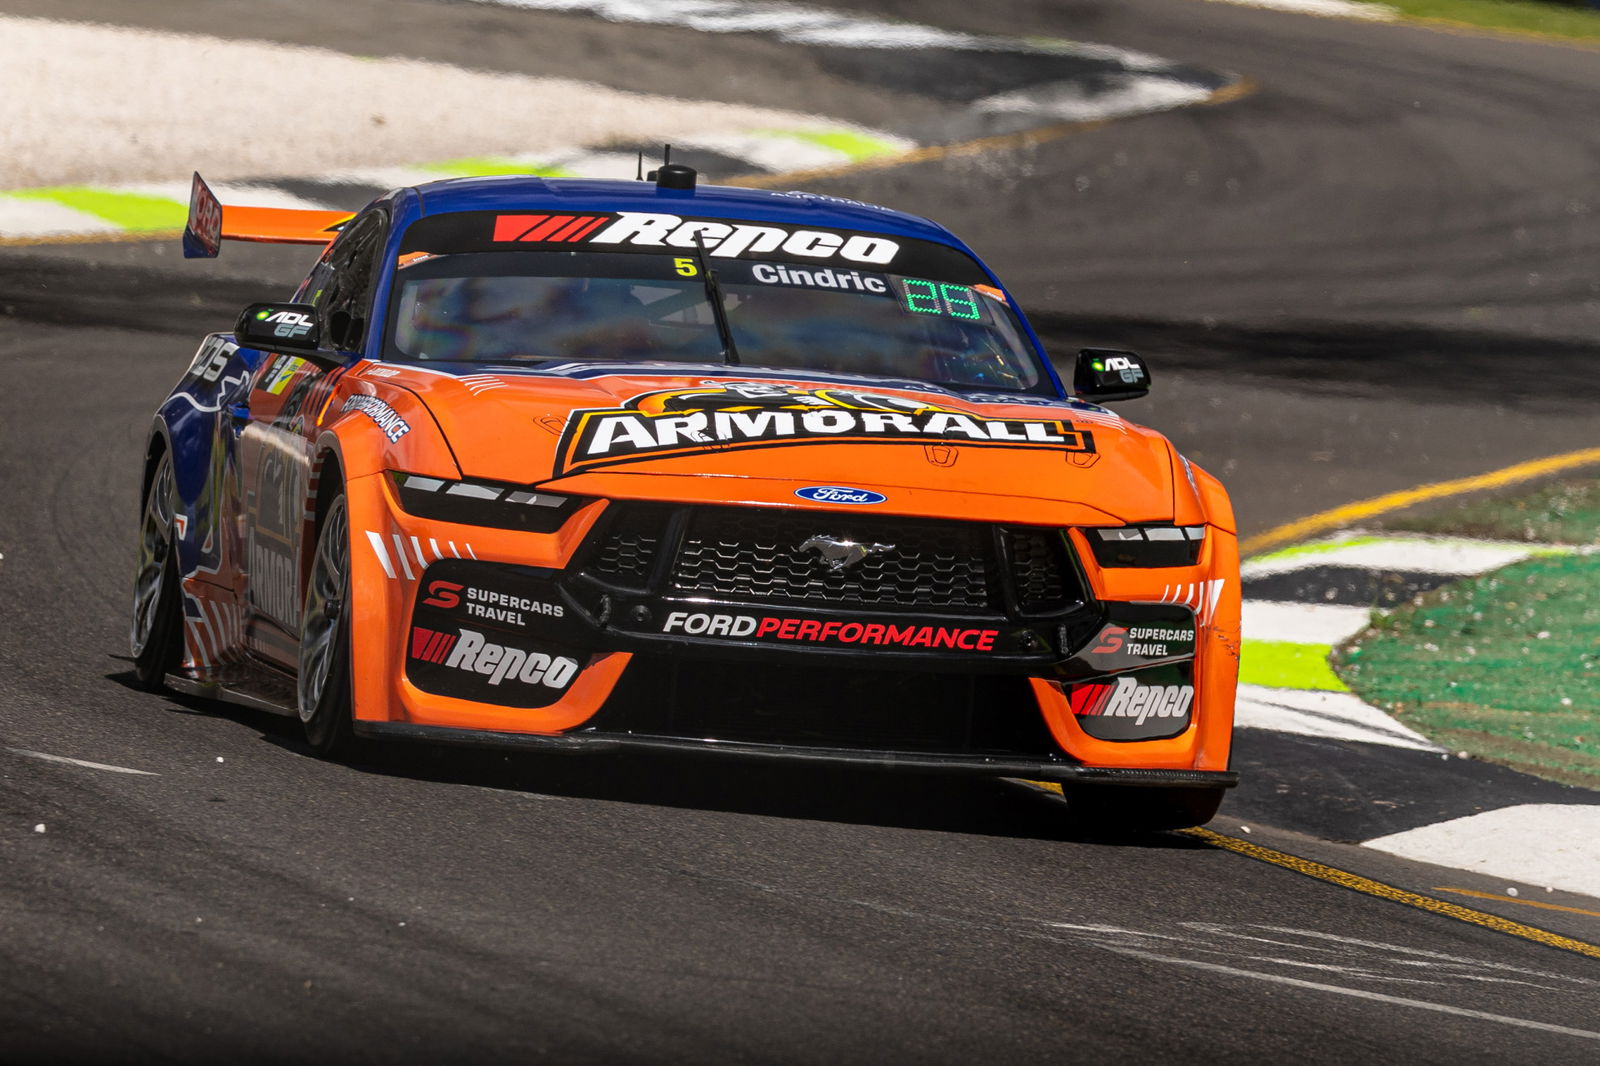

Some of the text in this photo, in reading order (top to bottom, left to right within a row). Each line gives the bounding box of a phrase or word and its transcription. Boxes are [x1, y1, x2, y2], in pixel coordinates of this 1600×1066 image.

[589, 211, 900, 265] Repco
[673, 257, 698, 277] 5
[751, 263, 887, 293] Cindric
[902, 279, 981, 320] 25
[812, 487, 869, 502] Ford
[466, 587, 564, 618] SUPERCARS
[466, 602, 526, 627] TRAVEL
[1127, 643, 1168, 656] TRAVEL
[1129, 627, 1194, 642] SUPERCARS
[445, 628, 579, 690] Repco
[1103, 676, 1195, 726] Repco
